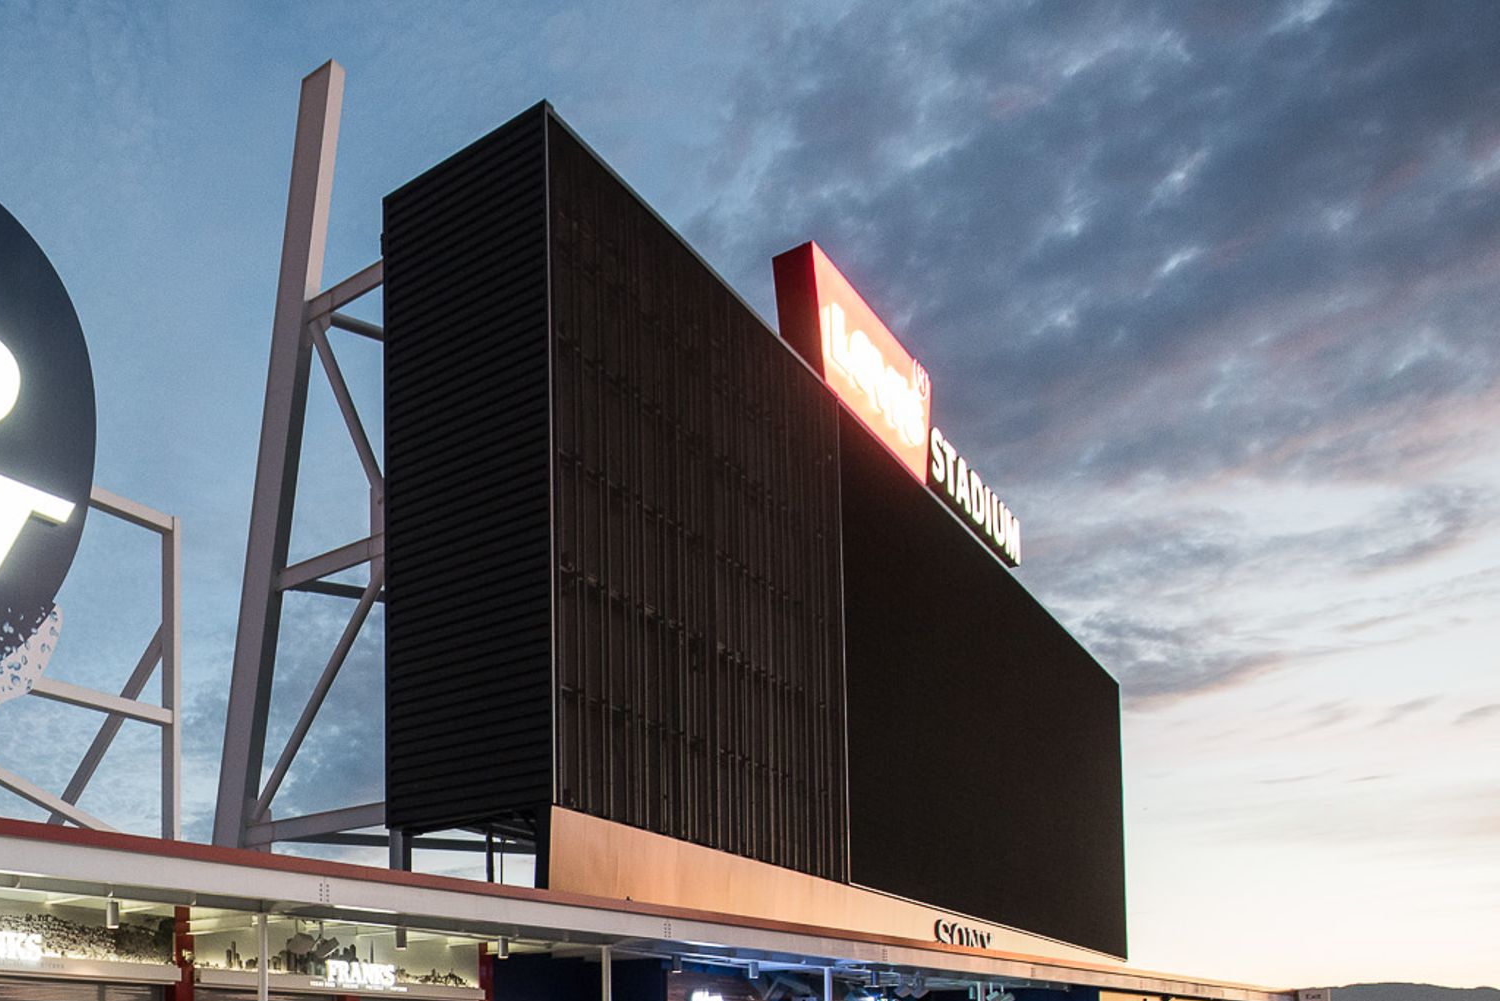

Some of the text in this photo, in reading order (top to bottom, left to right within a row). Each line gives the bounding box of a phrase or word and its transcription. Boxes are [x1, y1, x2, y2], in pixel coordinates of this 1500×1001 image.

[931, 426, 1021, 566] STADIUM
[934, 919, 991, 949] SONY
[325, 959, 396, 986] FRANKS
